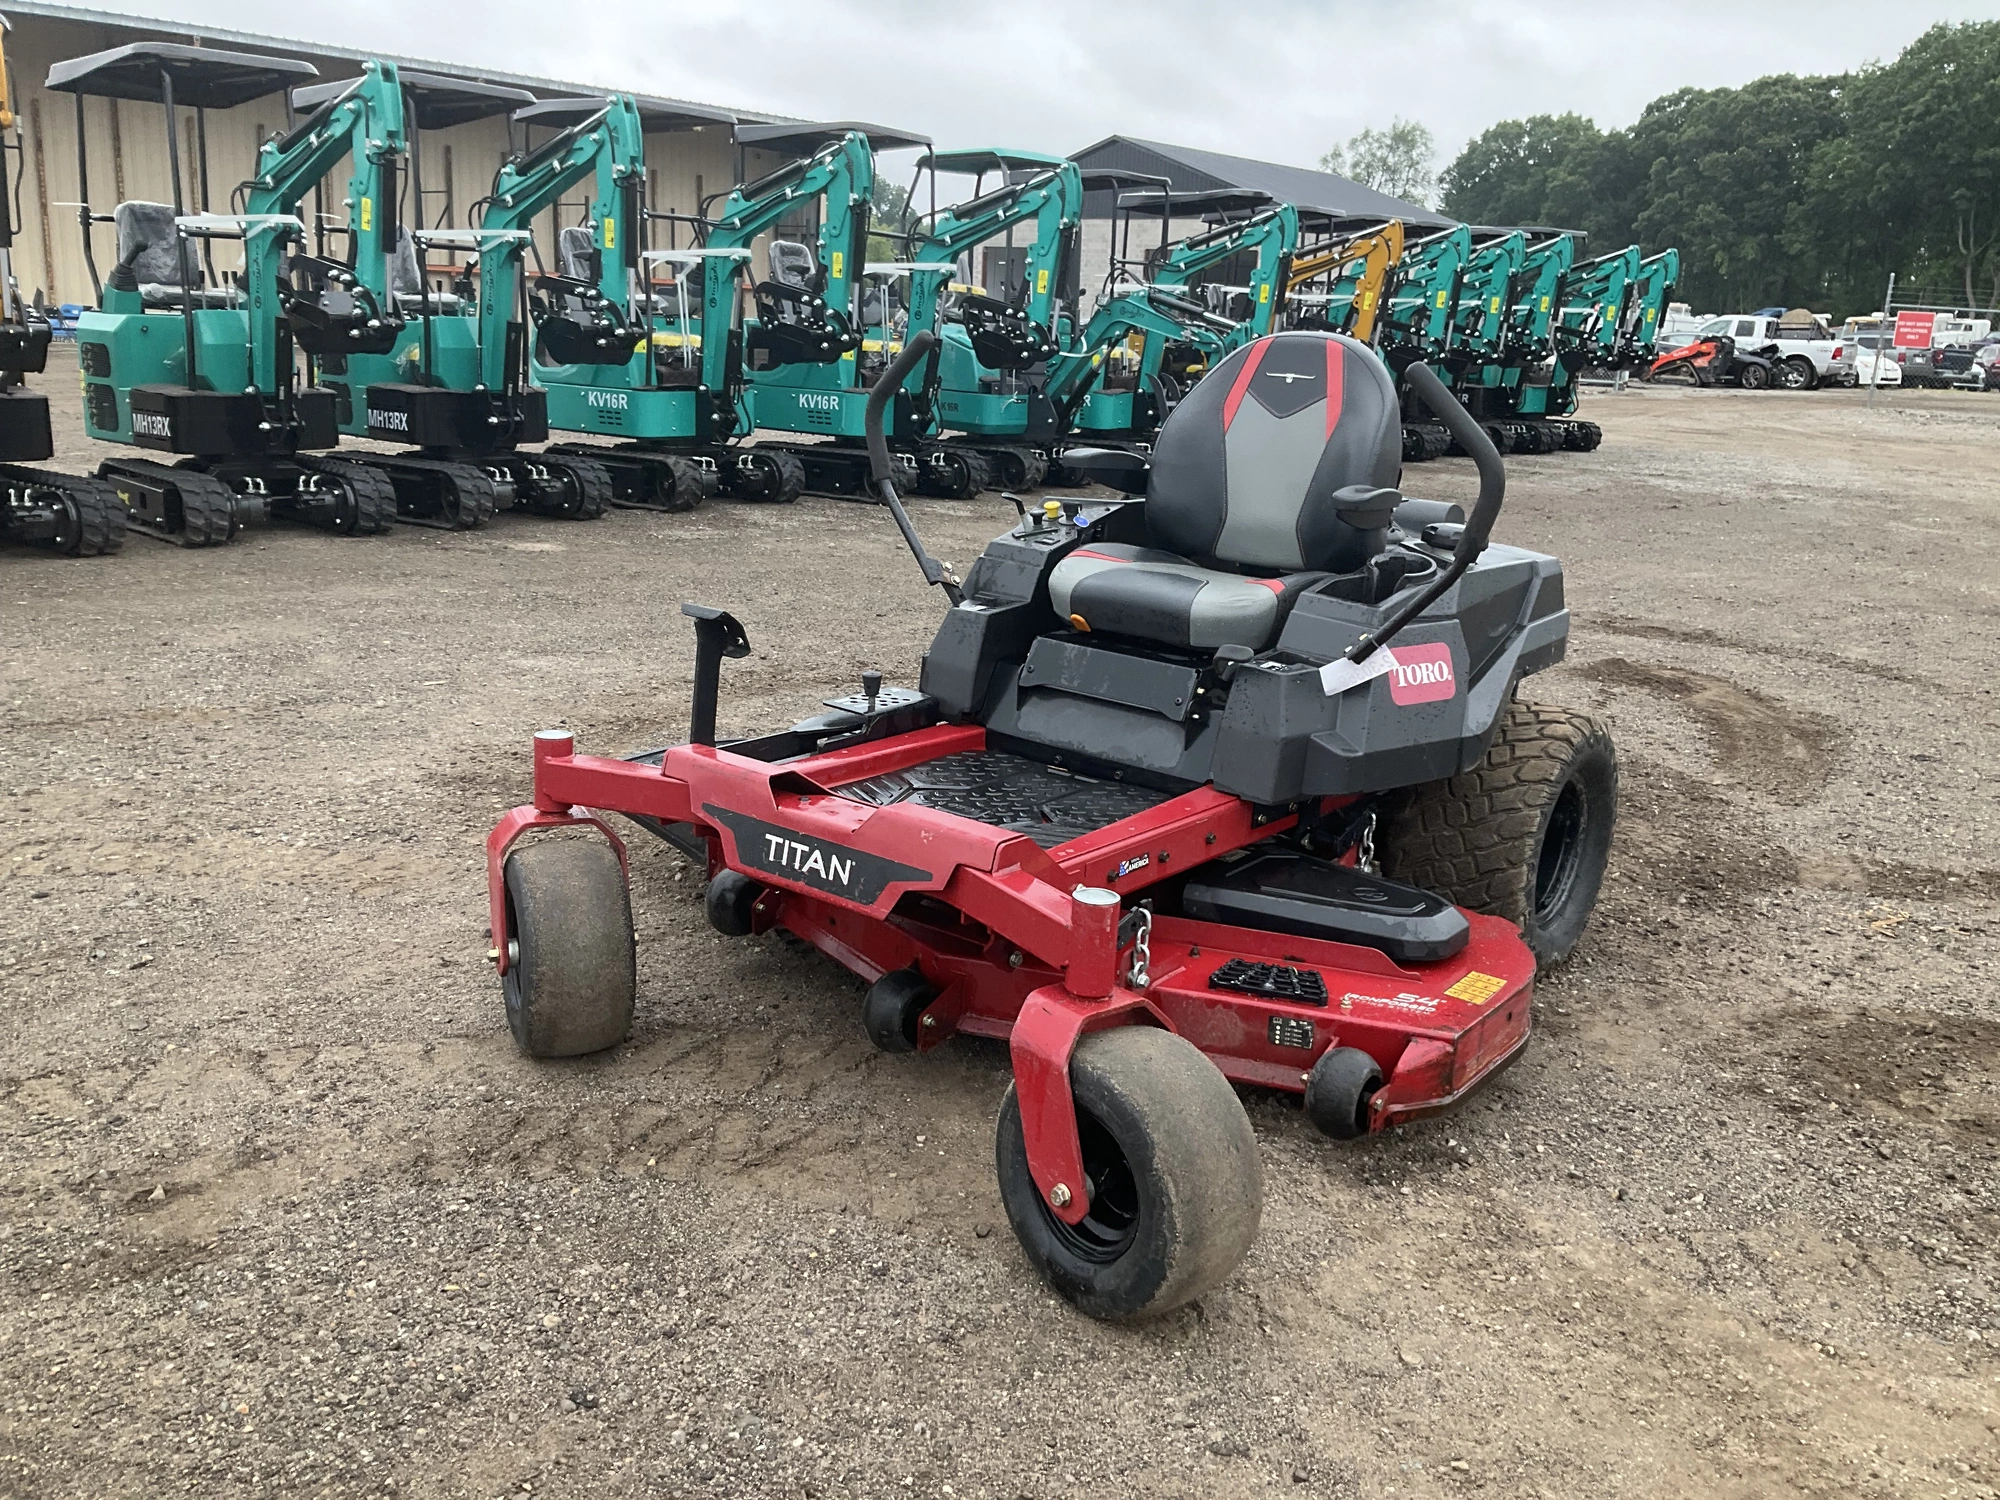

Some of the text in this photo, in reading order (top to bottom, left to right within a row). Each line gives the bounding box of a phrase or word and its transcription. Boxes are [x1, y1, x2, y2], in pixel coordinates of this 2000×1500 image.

[588, 391, 628, 409] KV16R
[799, 394, 839, 410] KV16R
[132, 413, 171, 437] MH13RX
[368, 408, 409, 431] MH13RX
[765, 833, 852, 885] TITAN
